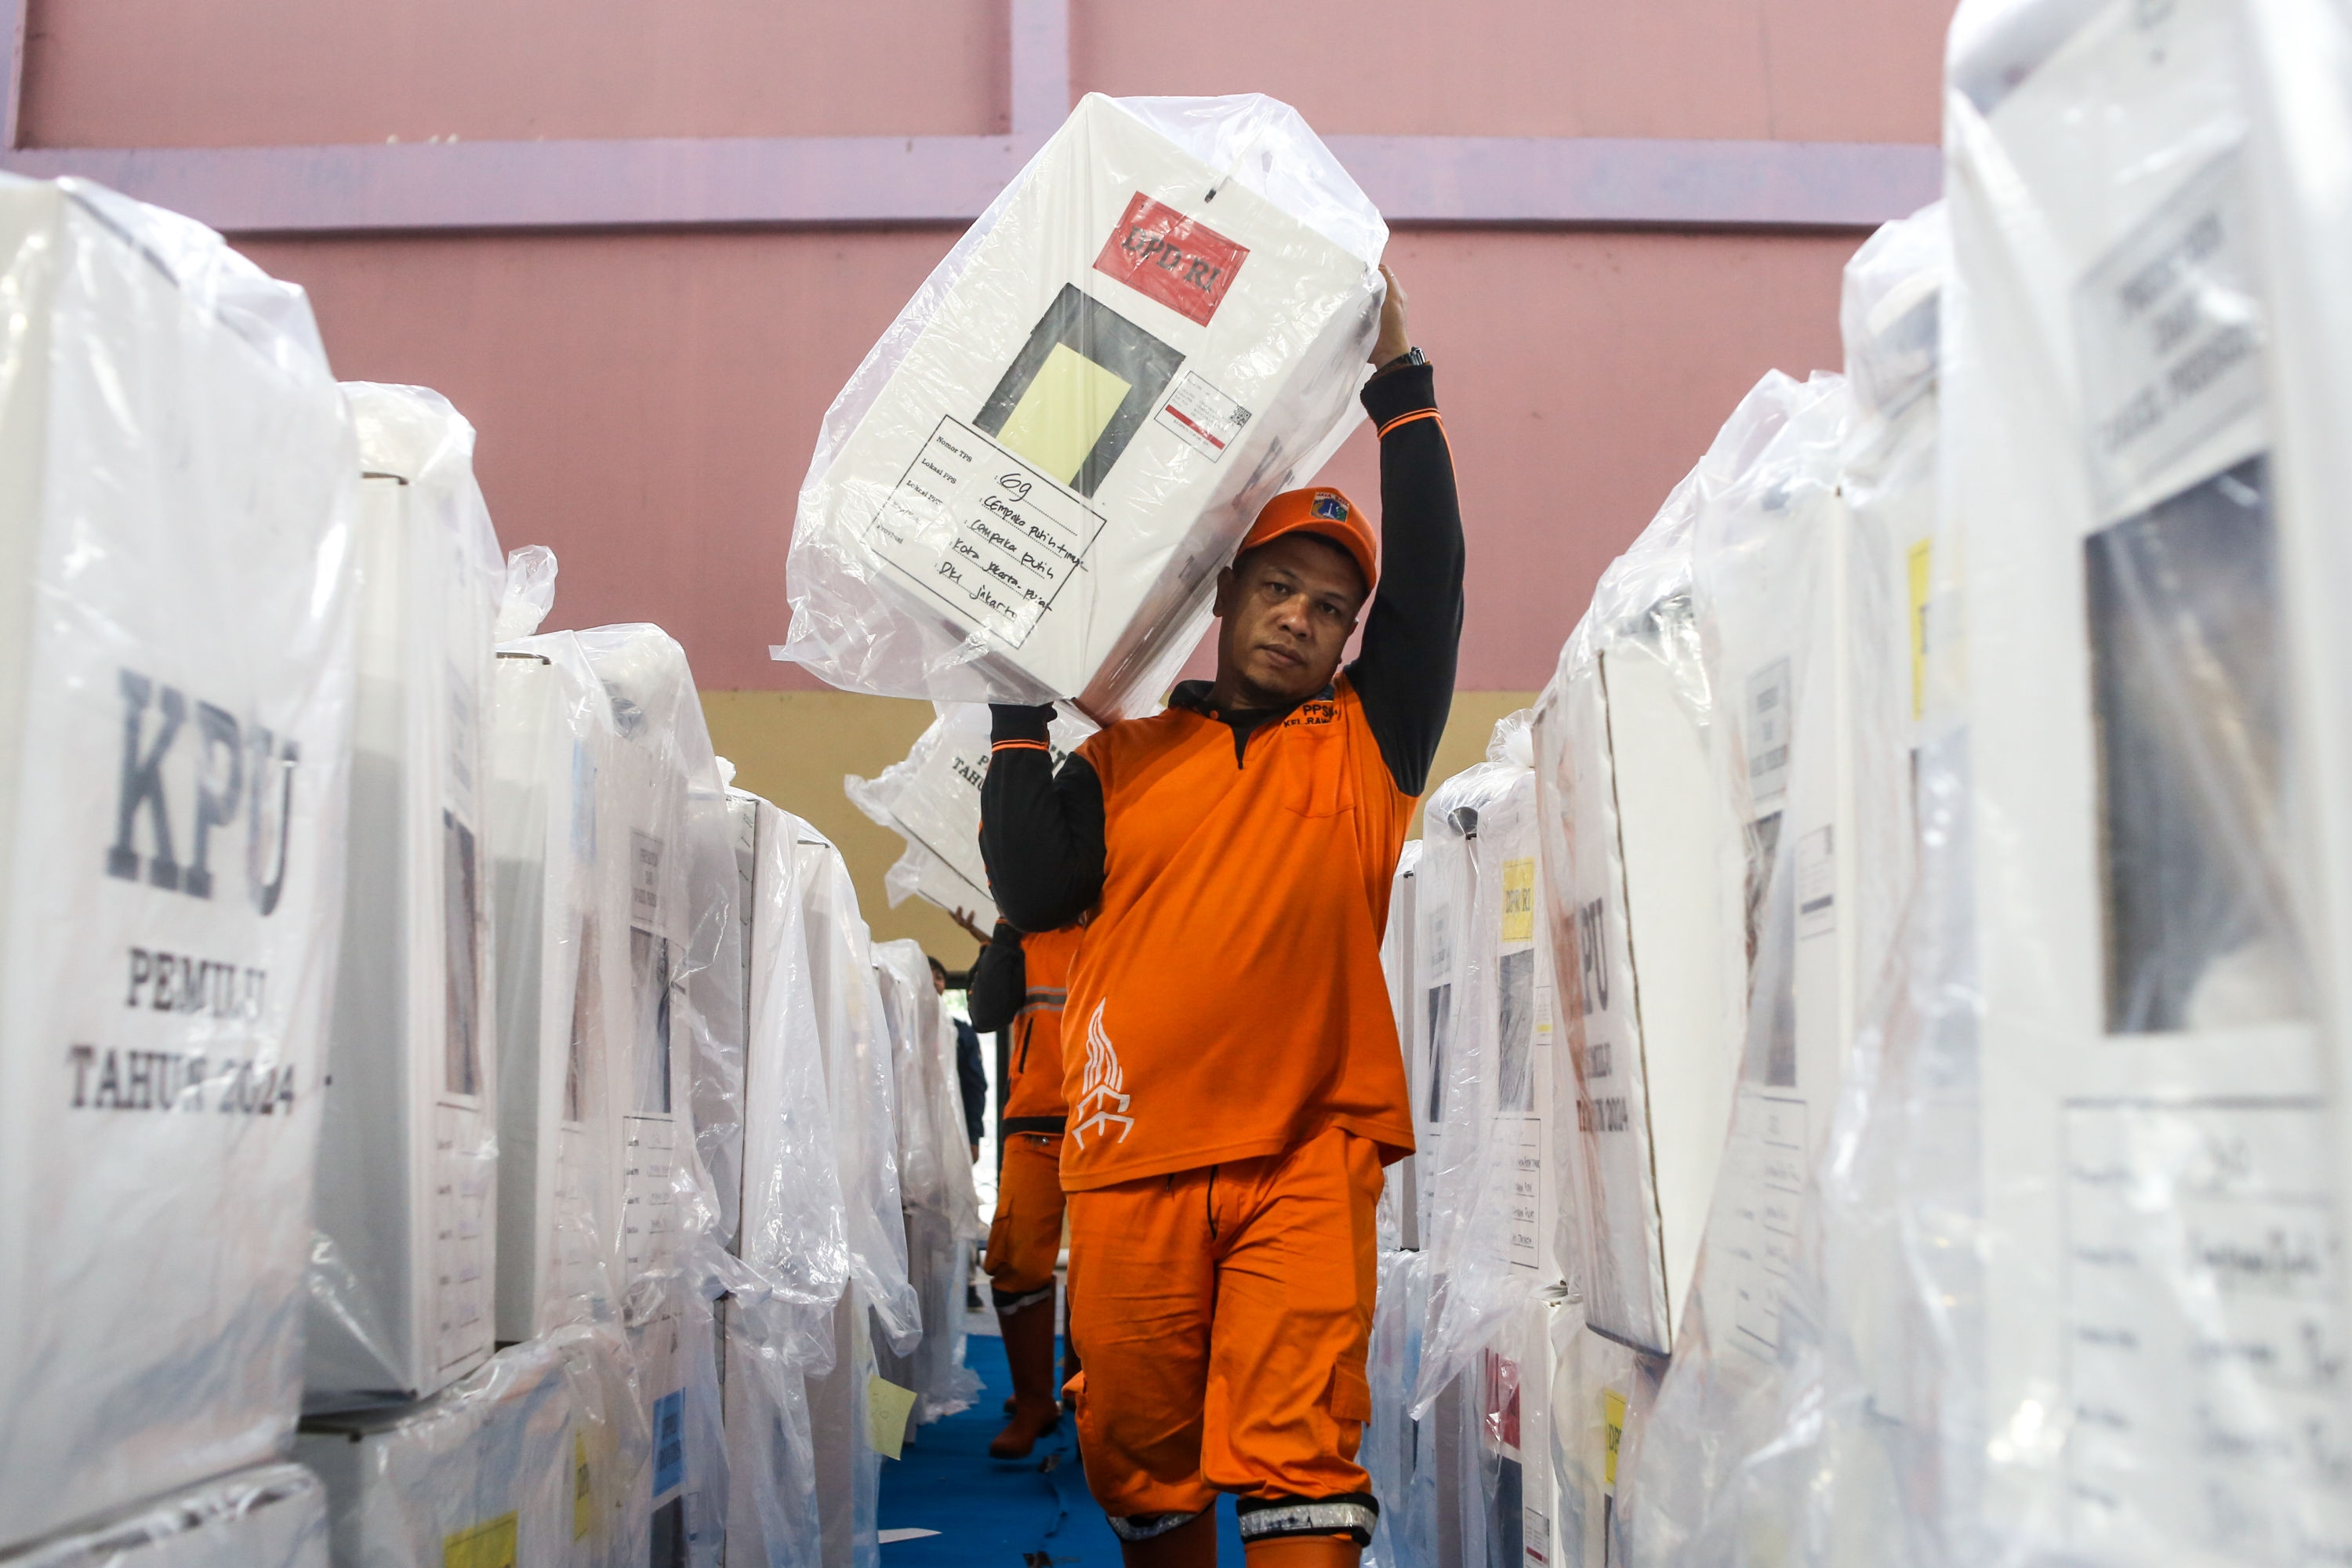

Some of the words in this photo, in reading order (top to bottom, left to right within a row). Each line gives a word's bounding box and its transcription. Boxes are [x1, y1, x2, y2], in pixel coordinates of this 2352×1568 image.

[1122, 225, 1181, 270] DPD
[1184, 257, 1221, 293] RI
[921, 458, 943, 476] Lokasi
[943, 472, 956, 485] PPS
[936, 436, 958, 454] Nomor
[960, 450, 973, 463] TPS
[105, 666, 299, 917] KPU
